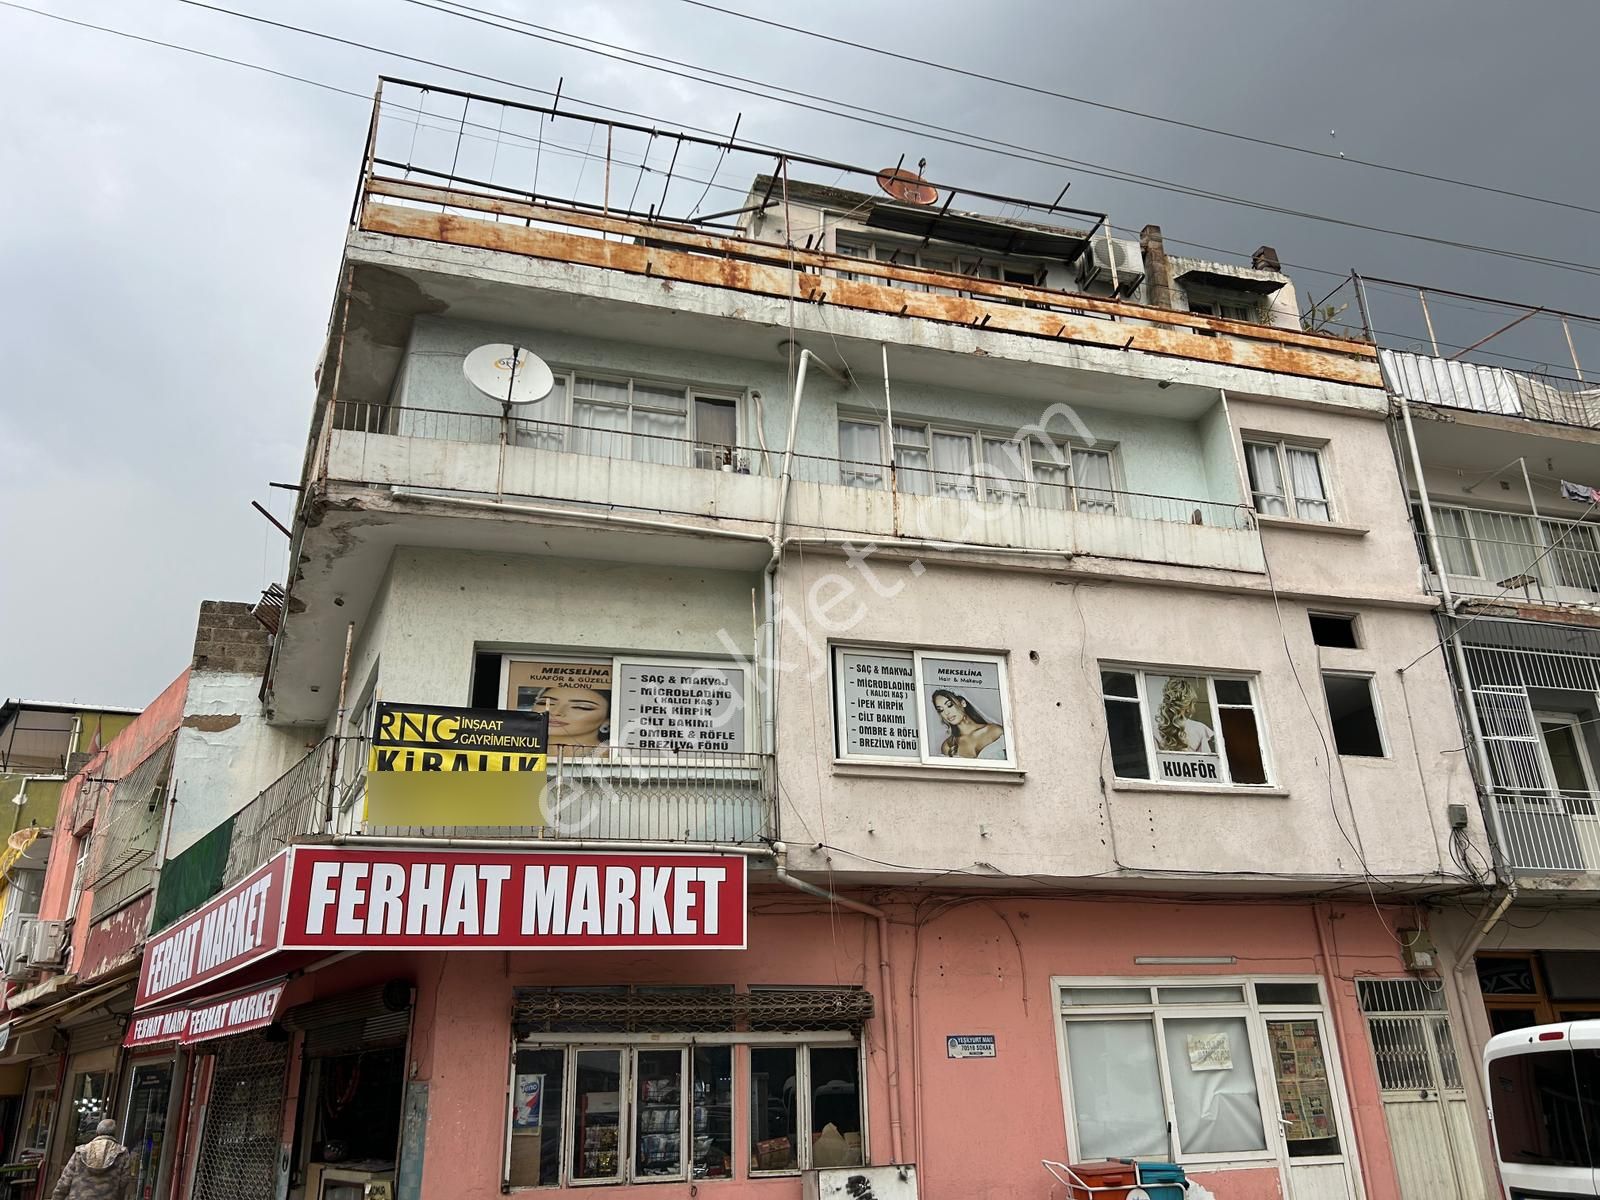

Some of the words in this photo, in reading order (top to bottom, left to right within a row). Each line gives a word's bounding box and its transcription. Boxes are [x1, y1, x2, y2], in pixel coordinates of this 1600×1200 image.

[541, 667, 609, 676] MEKSELİNA
[856, 664, 872, 675] SAÇ
[874, 666, 879, 674] &
[881, 666, 913, 676] MAKYAJ
[938, 668, 982, 677] MEKSELİNA
[530, 674, 564, 682] KUAFÖR
[640, 674, 664, 684] SAÇ
[668, 676, 676, 684] &
[870, 689, 890, 698] KALICI
[639, 704, 667, 715] İPEK
[671, 706, 712, 716] KİRPİK
[857, 697, 876, 709] İPEK
[877, 699, 904, 711] KİRPİK
[640, 716, 664, 726] CİLT
[668, 718, 713, 728] BAKIMI
[858, 711, 874, 722] CİLT
[876, 713, 906, 724] BAKIMI
[378, 712, 460, 744] RNG
[461, 716, 504, 732] İNŞAAT
[639, 729, 684, 739] OMBRE
[688, 731, 696, 739] &
[699, 730, 735, 740] RÖFLE
[859, 725, 888, 737] OMBRE
[889, 728, 895, 737] &
[460, 733, 541, 748] GAYRİMENKUL
[698, 741, 729, 751] FÖNÜ
[859, 737, 895, 749] BREZİLYA
[896, 739, 917, 751] FÖNÜ
[1162, 760, 1217, 779] KUAFÖR
[304, 861, 512, 935] FERHAT
[519, 864, 727, 936] MARKET
[144, 919, 202, 998] FERHAT
[196, 872, 272, 975] MARKET
[188, 1002, 230, 1036] FERHAT
[227, 987, 282, 1026] MARKET
[133, 1015, 165, 1041] FERHAT
